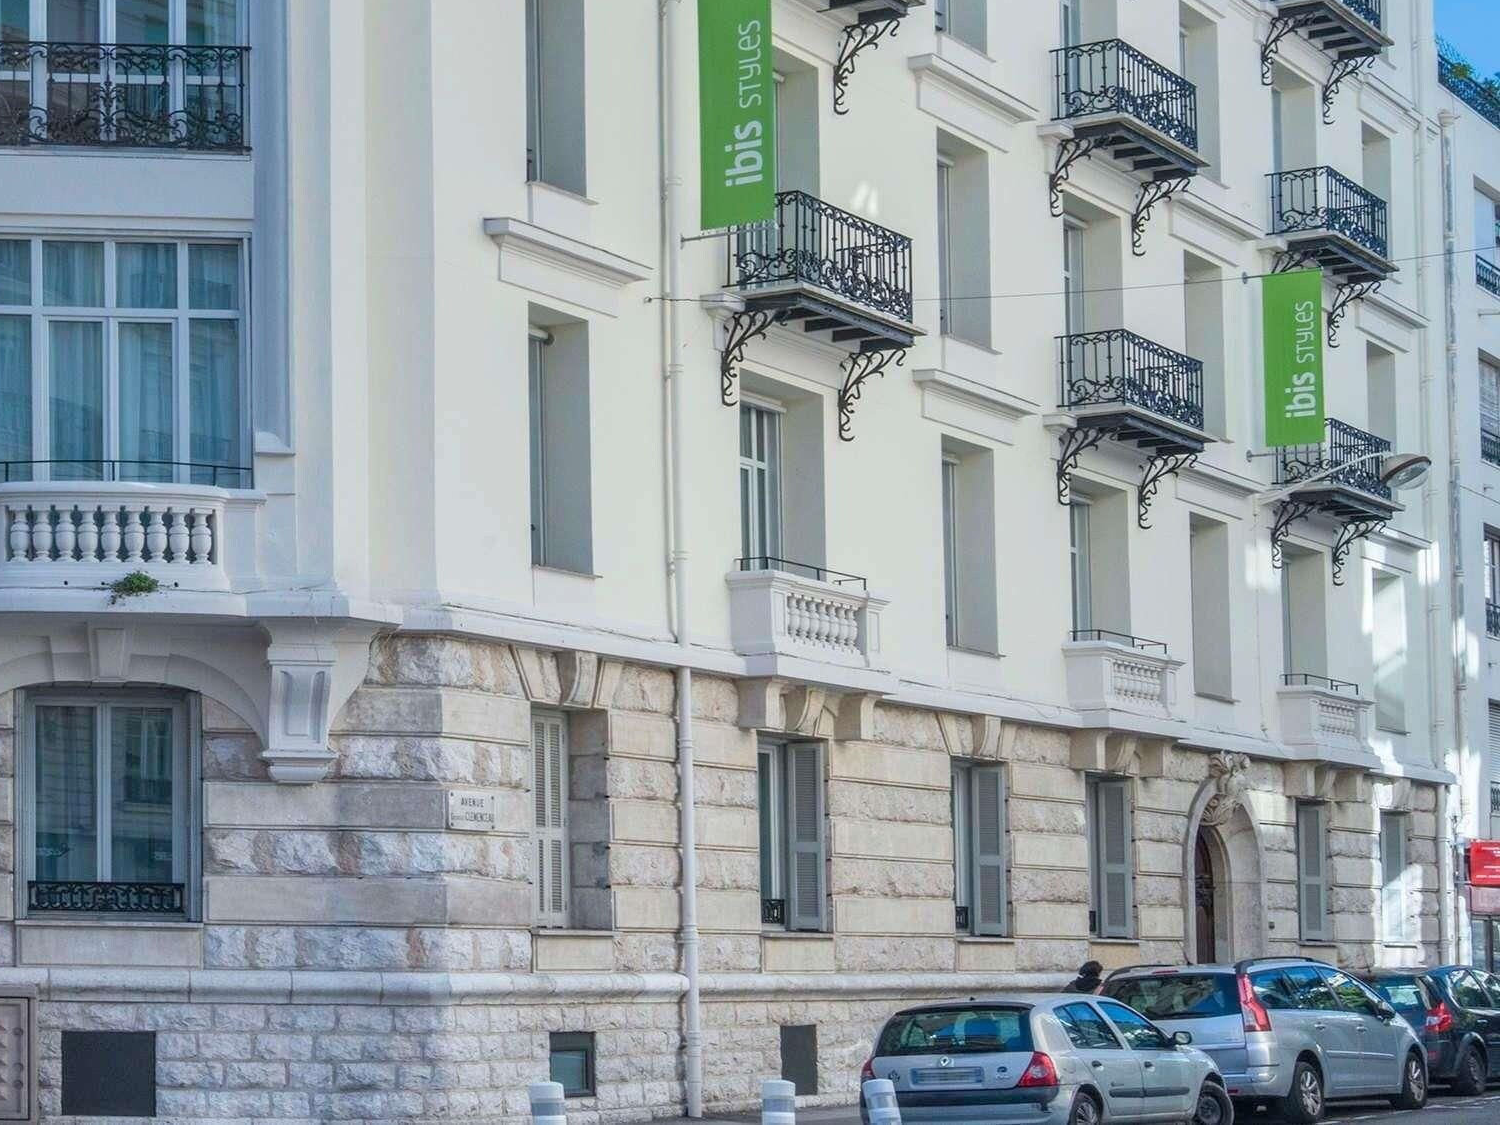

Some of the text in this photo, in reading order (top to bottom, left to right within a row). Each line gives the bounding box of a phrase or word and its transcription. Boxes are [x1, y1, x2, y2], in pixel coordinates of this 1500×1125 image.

[724, 120, 763, 187] ibis
[1285, 372, 1316, 418] ibis
[461, 797, 484, 807] AVENUE
